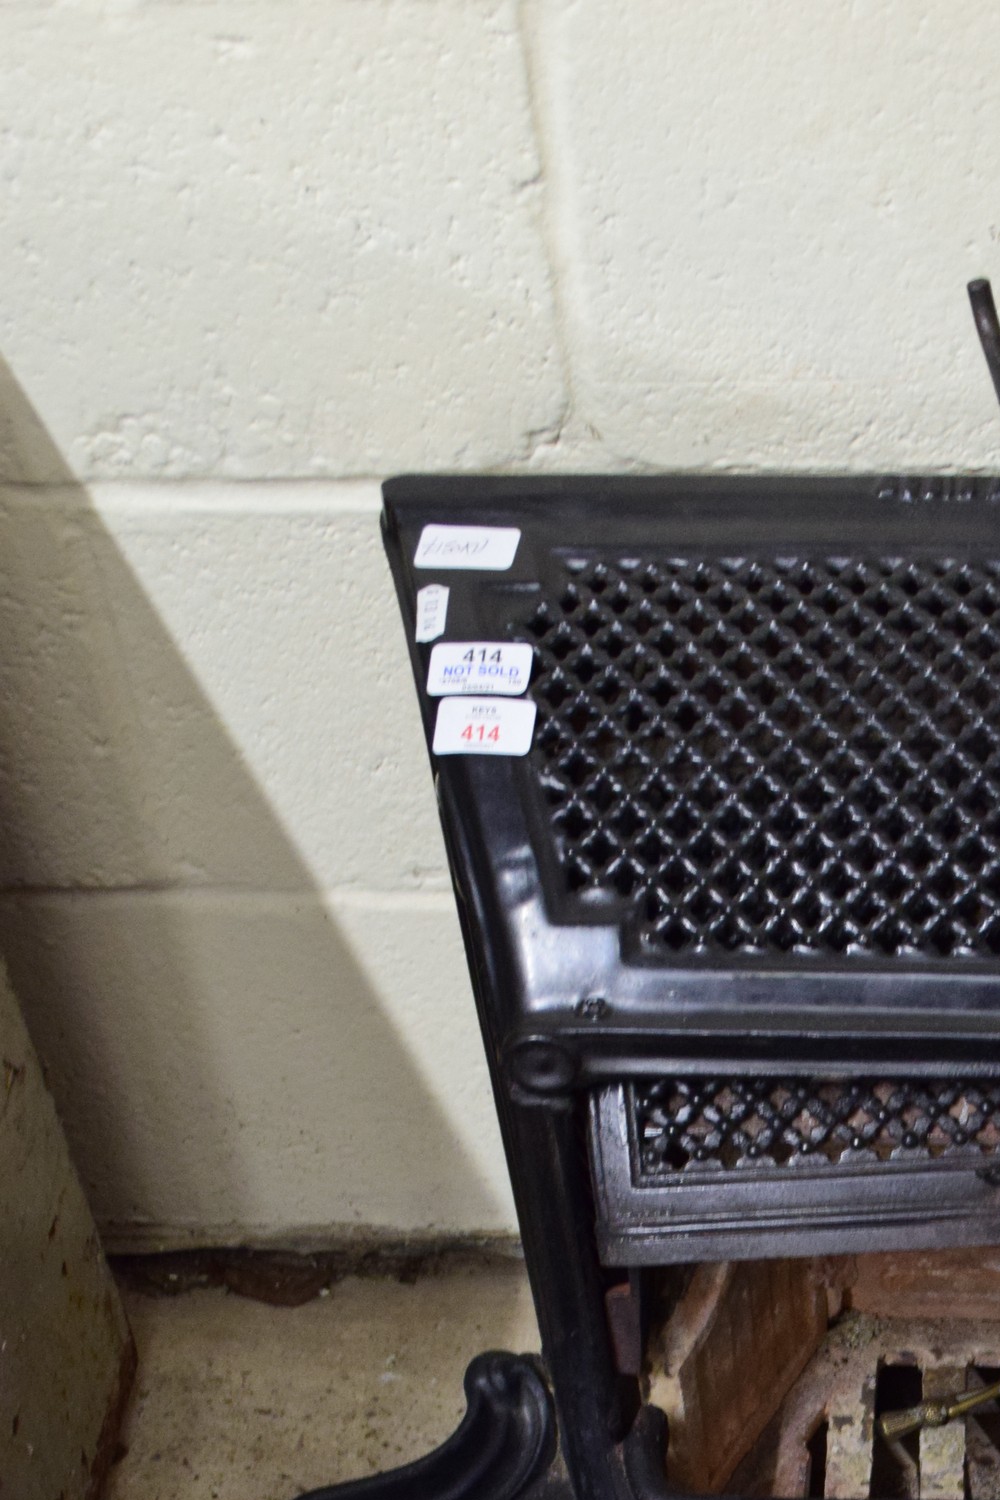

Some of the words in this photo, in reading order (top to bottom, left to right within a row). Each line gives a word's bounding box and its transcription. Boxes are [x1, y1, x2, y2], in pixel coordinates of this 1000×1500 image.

[462, 647, 502, 663] 414
[443, 664, 472, 677] NOT
[478, 664, 520, 677] SOLD
[472, 705, 497, 714] KEYS
[460, 723, 500, 742] 414
